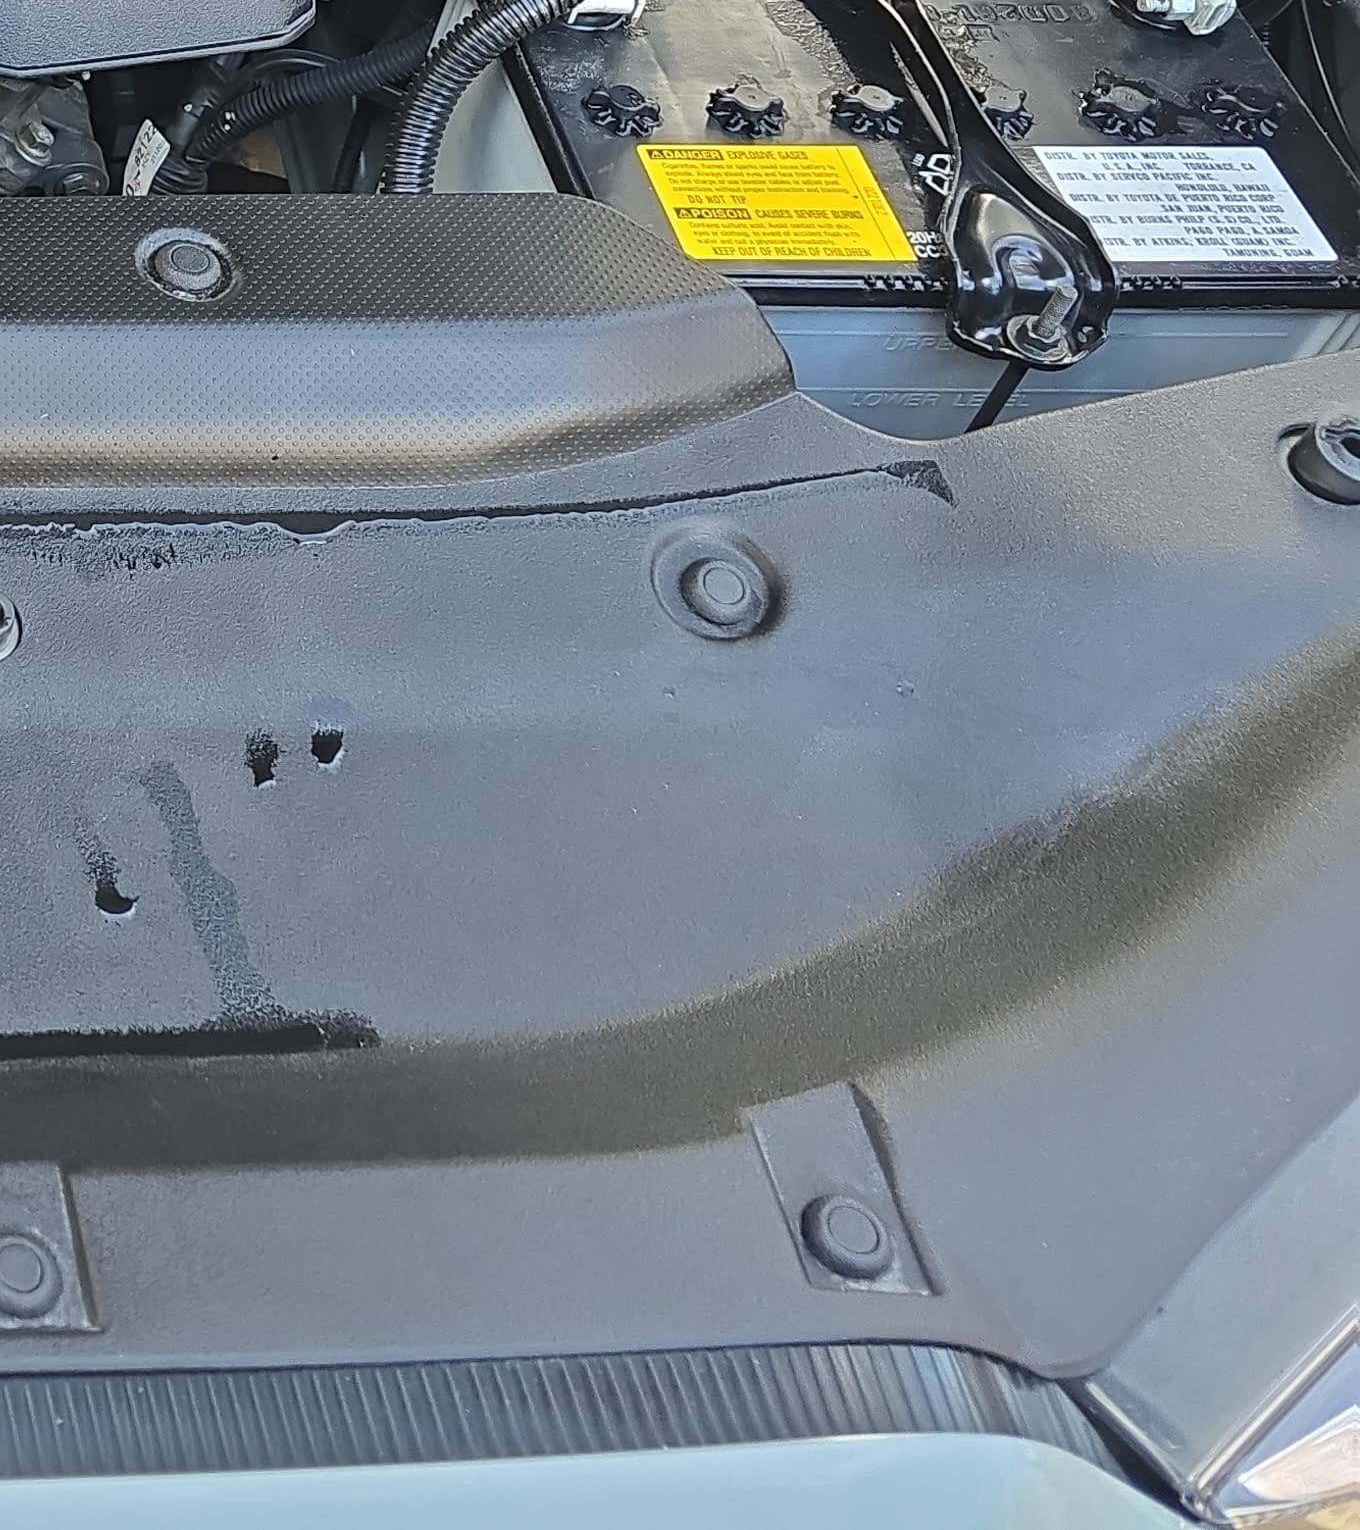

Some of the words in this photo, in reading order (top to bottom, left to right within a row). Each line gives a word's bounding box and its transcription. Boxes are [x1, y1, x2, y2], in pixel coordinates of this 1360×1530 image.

[664, 150, 721, 160] DANGER
[728, 150, 775, 160] EXPLOSIVE
[778, 151, 809, 160] GASES
[1044, 152, 1078, 160] DISTR.
[1082, 152, 1097, 160] BY
[1100, 152, 1139, 160] TOYOTA
[1140, 152, 1177, 160] MOTOR
[1179, 152, 1214, 160] SALES,
[1183, 162, 1241, 171] TORRANCE,
[1240, 162, 1257, 171] CA
[1056, 173, 1090, 181] DISTR.
[1092, 173, 1108, 181] BY
[1110, 173, 1150, 181] SERVCO
[1152, 173, 1193, 181] PACIFIC
[1194, 173, 1219, 181] INC.
[1175, 184, 1232, 192] HONOLULU,
[1233, 184, 1271, 192] HAWAII
[688, 195, 703, 205] DO
[707, 195, 726, 205] NOT
[731, 196, 747, 205] TIP
[1069, 194, 1103, 202] DISTR.
[1105, 194, 1120, 202] BY
[1123, 194, 1164, 202] TOYOTA
[1164, 194, 1180, 202] DE
[1180, 194, 1220, 202] PUERTO
[1222, 194, 1248, 202] RICO
[690, 209, 748, 218] POISON
[756, 210, 793, 219] CAUSES
[795, 210, 829, 219] SEVERE
[832, 210, 864, 219] BURNS
[1132, 238, 1147, 246] BY
[1151, 238, 1194, 246] ATKINS,
[1195, 238, 1229, 246] KROLL
[1231, 238, 1269, 246] (GUAM)
[1271, 238, 1296, 246] INC.
[712, 247, 738, 256] KEEP
[740, 247, 759, 256] OUT
[761, 247, 770, 256] OF
[772, 247, 804, 257] REACH
[807, 247, 817, 257] OF
[818, 247, 871, 257] CHILDREN
[1221, 249, 1282, 257] TAMUNING,
[1283, 249, 1314, 257] GUAM
[882, 336, 958, 351] UPPE
[848, 392, 940, 407] LOWER
[952, 392, 1030, 407] LEEL
